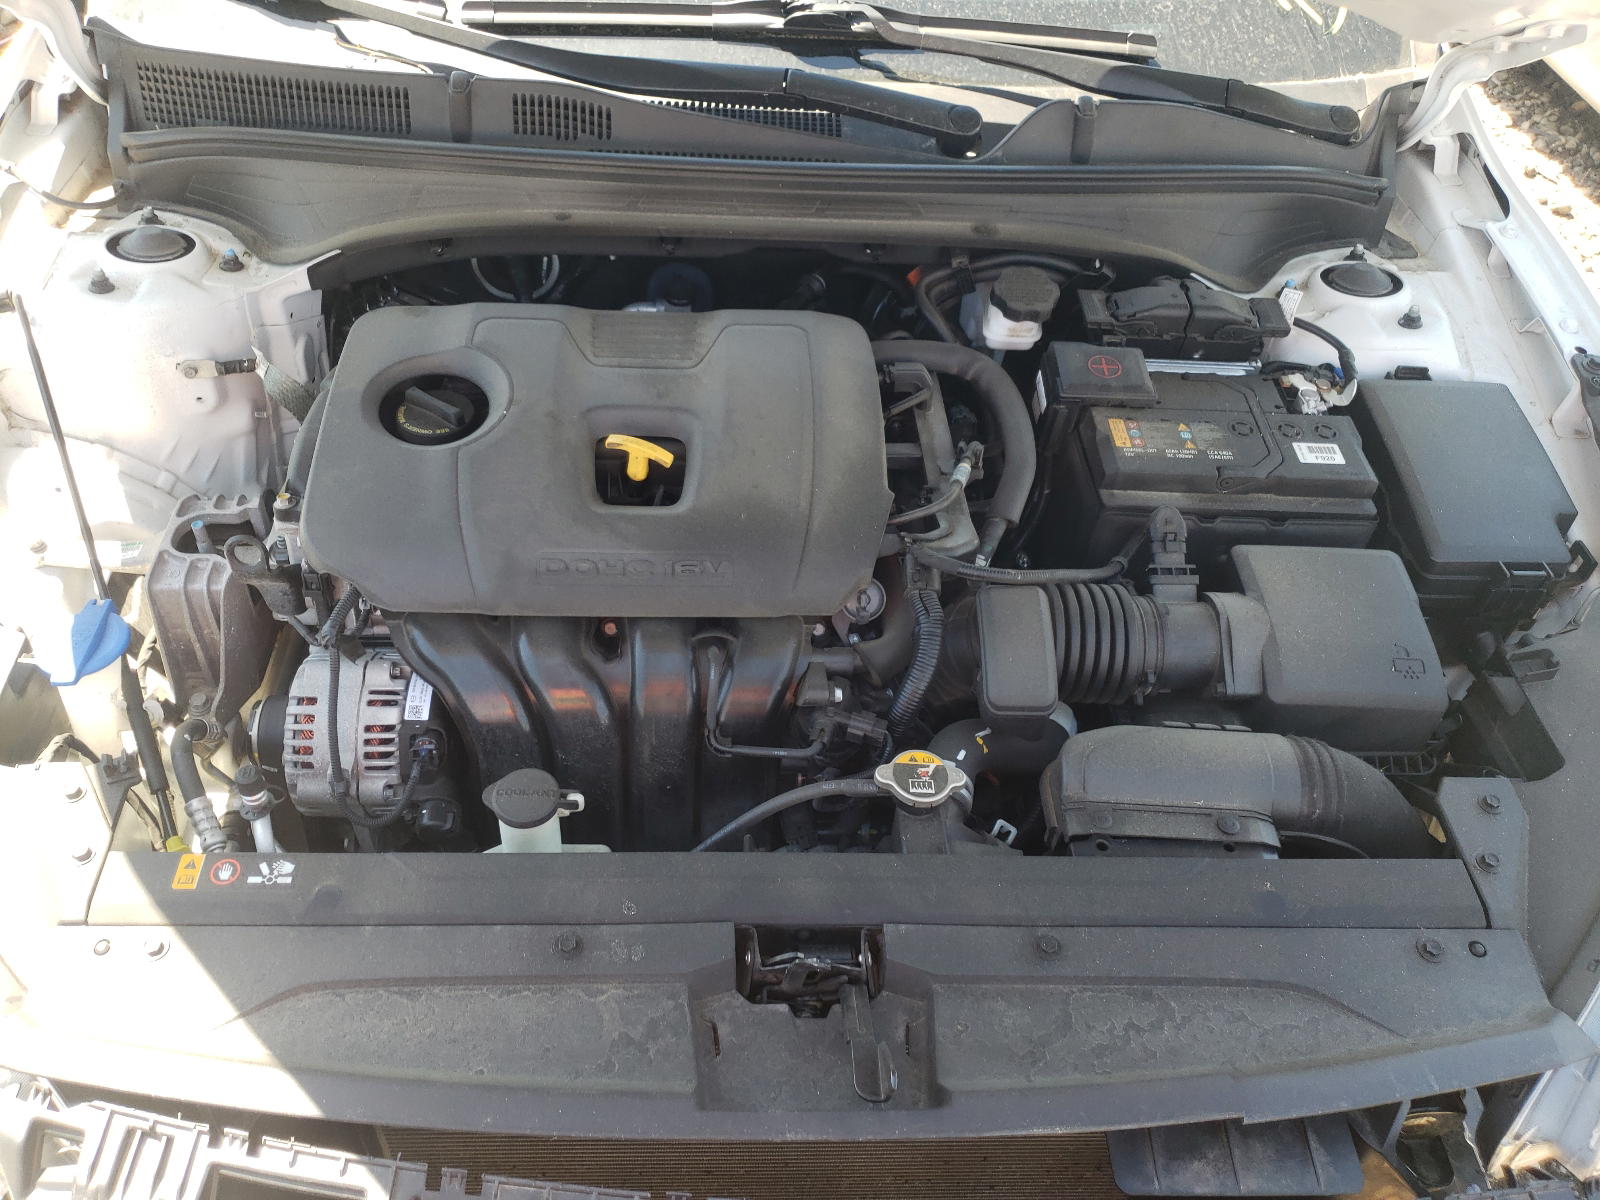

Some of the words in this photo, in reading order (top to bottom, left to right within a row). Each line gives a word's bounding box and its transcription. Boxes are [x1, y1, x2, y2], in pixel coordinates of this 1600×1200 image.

[536, 557, 656, 578] DOHC
[664, 558, 735, 578] 16V
[496, 787, 556, 800] COOLANT
